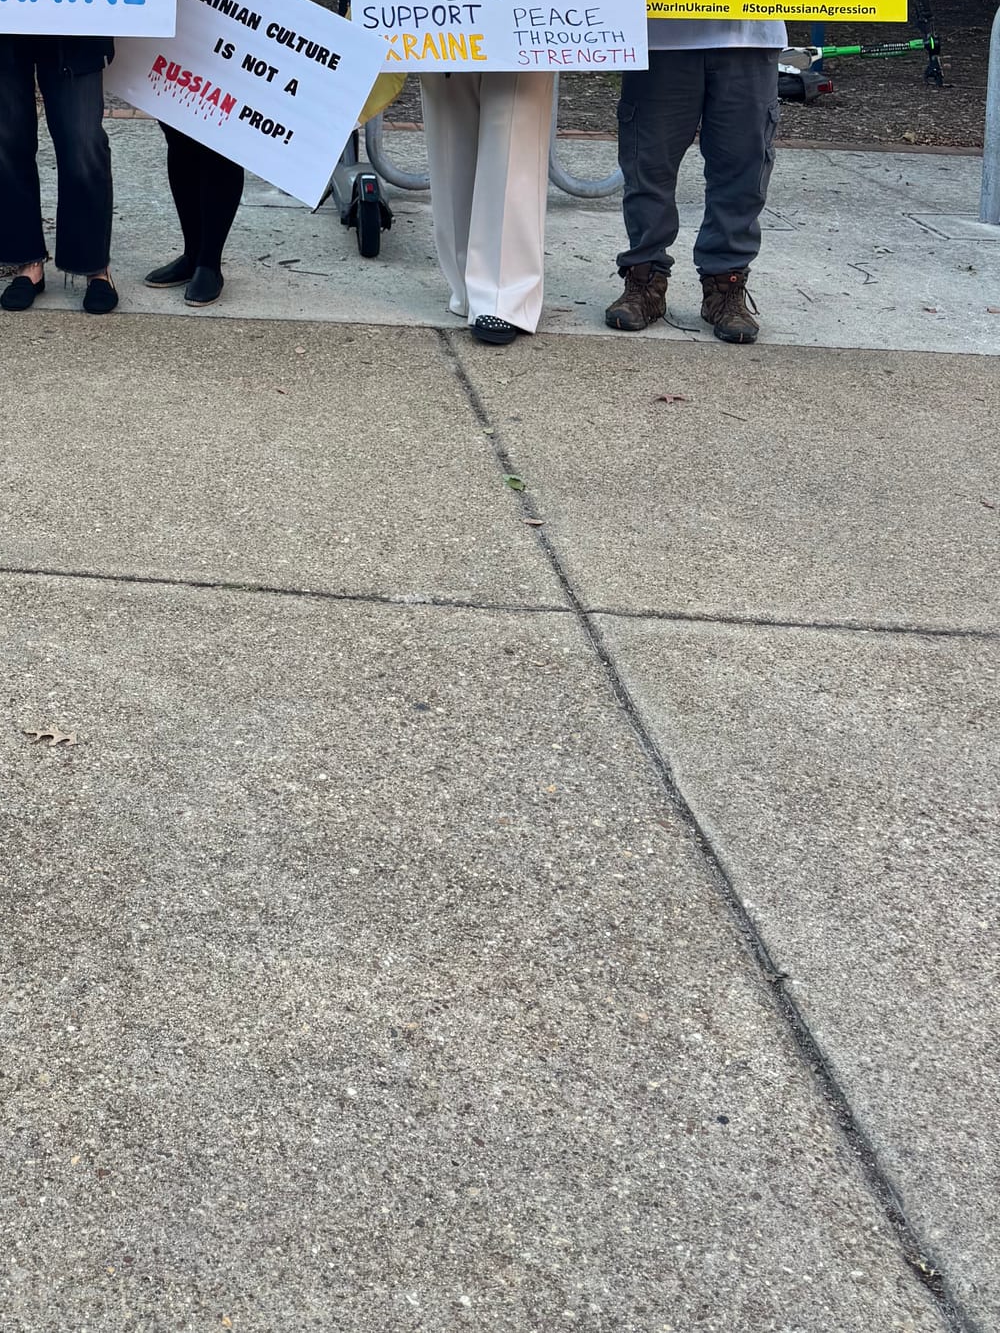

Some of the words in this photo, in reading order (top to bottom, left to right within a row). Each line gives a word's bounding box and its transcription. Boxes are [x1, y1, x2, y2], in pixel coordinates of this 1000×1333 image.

[363, 4, 482, 29] SUPPORT
[513, 7, 604, 27] PEACE
[647, 2, 730, 13] WarInUkraine
[742, 3, 876, 17] #StopRussianAgression
[266, 22, 341, 71] CULTURE
[383, 32, 488, 62] KRAINE
[513, 30, 625, 46] THROUGTH
[213, 38, 236, 60] IS
[241, 53, 279, 83] NOT
[284, 78, 299, 96] A
[518, 47, 636, 65] STRENGTH
[151, 54, 237, 116] RUSSIAN
[238, 105, 294, 145] PROP!
